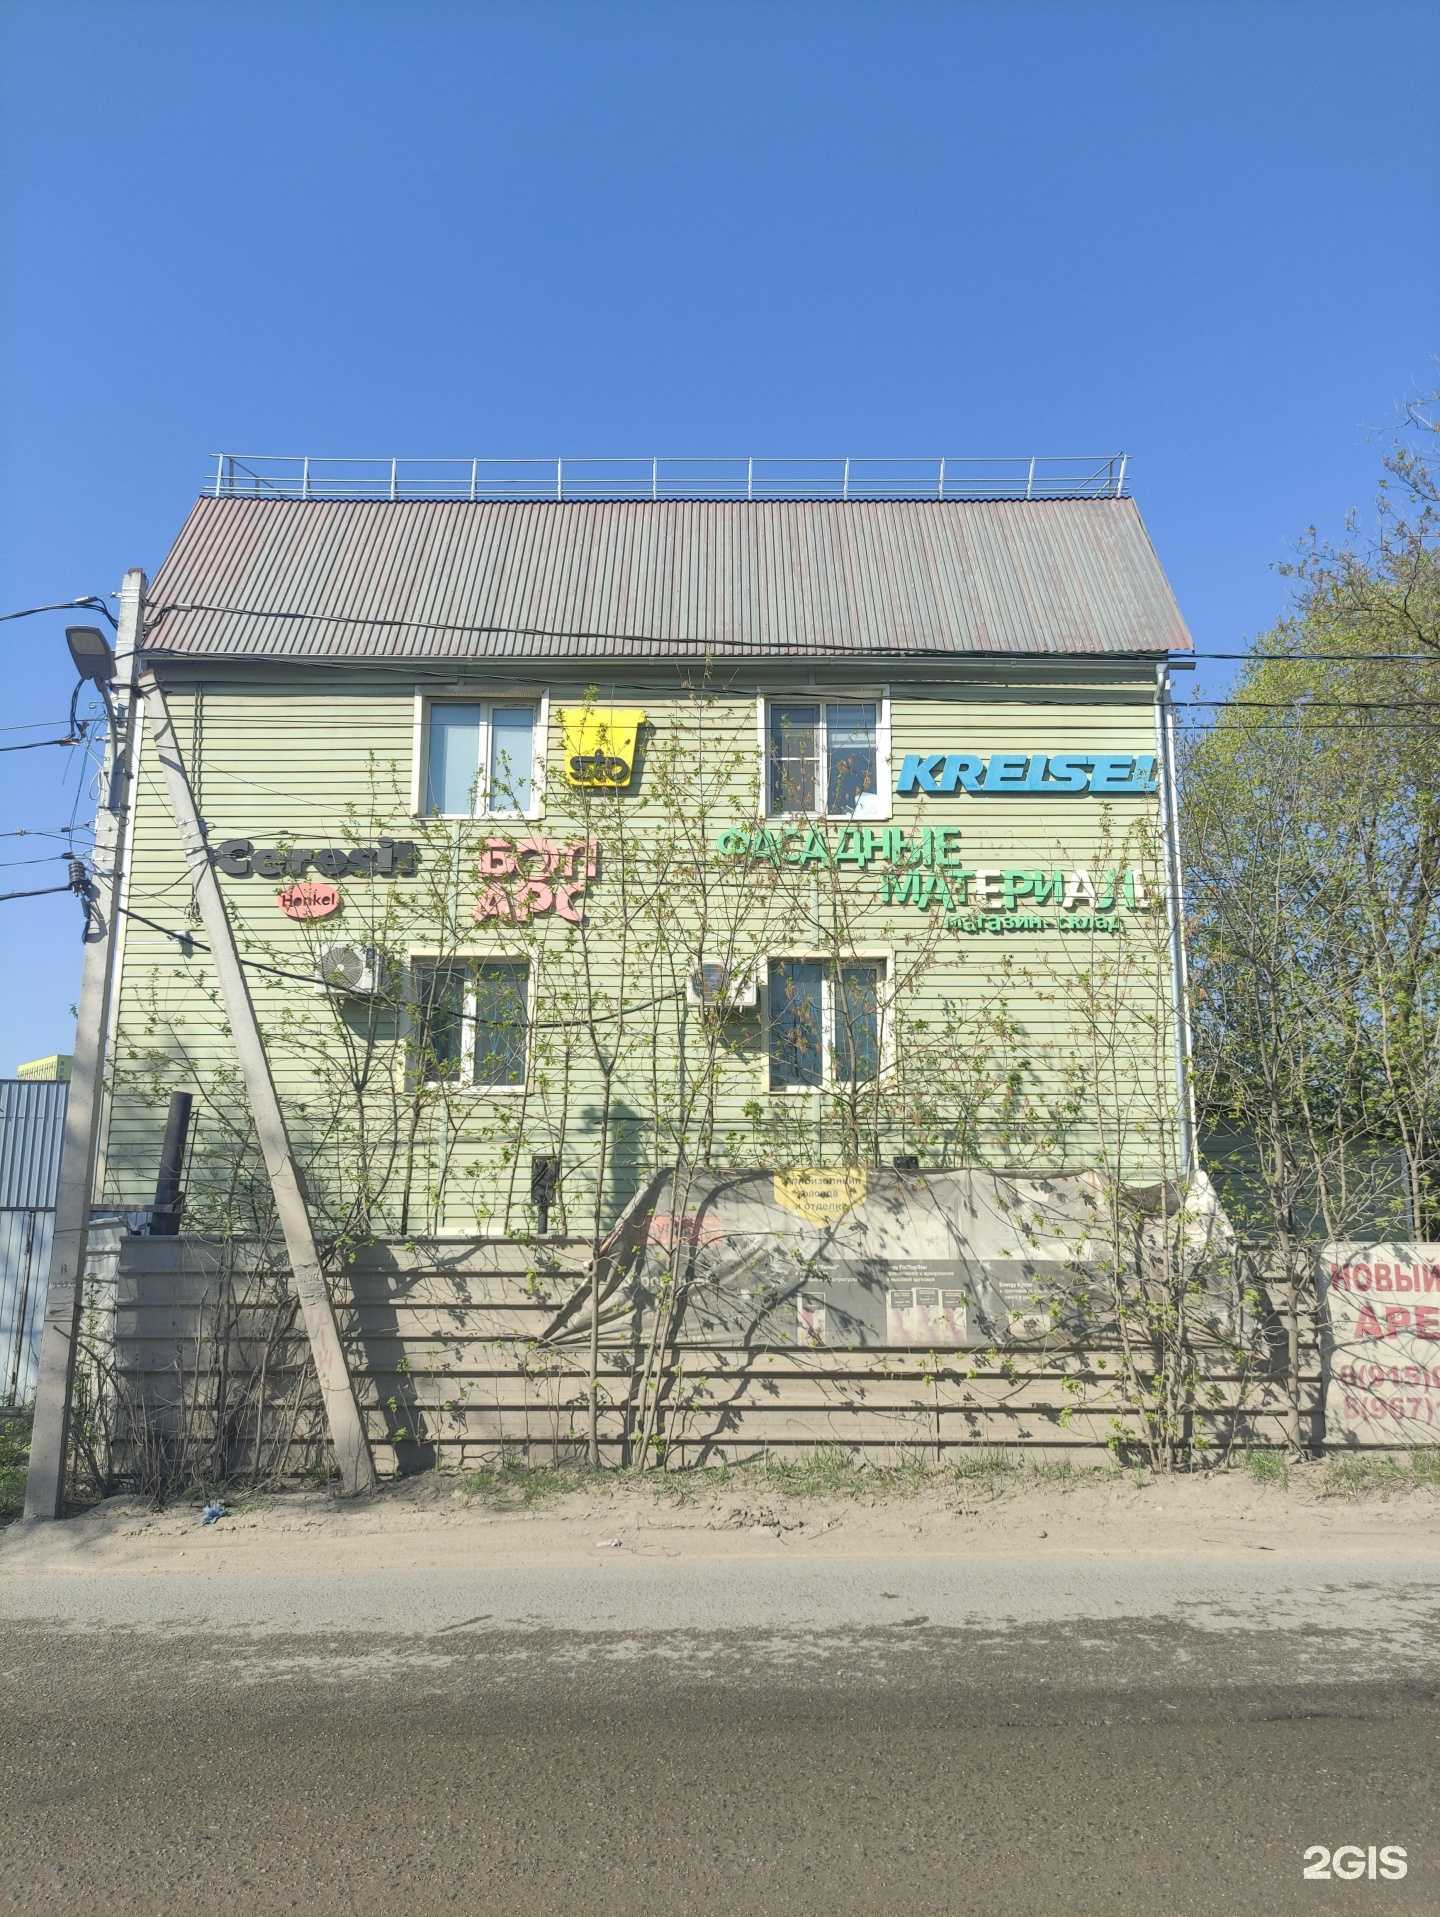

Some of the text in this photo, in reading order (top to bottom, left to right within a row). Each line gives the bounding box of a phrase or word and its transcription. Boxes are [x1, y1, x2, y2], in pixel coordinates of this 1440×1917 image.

[569, 749, 630, 782] sto
[896, 754, 1160, 795] KREISEL
[215, 837, 419, 876] Ceresit
[717, 826, 962, 868] ФАСАДНЫЕ
[281, 893, 335, 907] Henkel
[473, 878, 588, 922] АРС
[1331, 1257, 1440, 1293] НОВЫЙ
[1354, 1304, 1440, 1341] АРЕ
